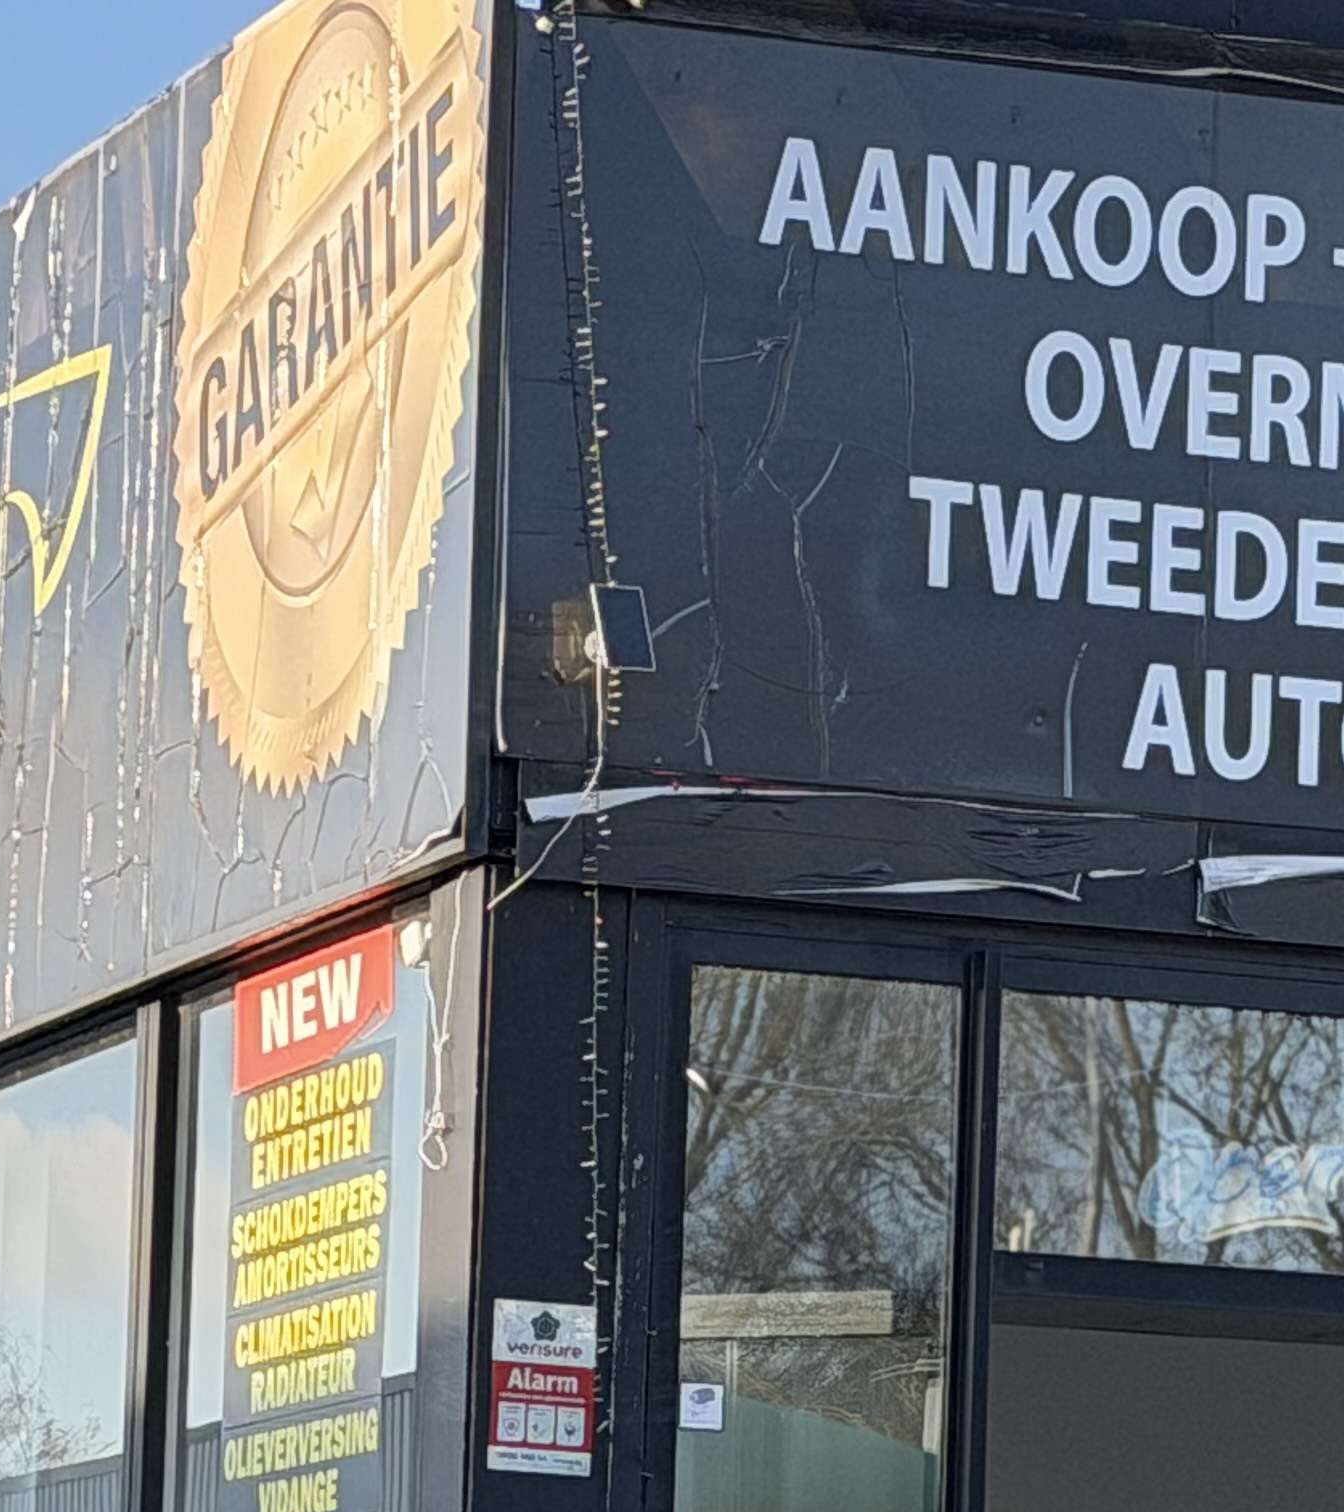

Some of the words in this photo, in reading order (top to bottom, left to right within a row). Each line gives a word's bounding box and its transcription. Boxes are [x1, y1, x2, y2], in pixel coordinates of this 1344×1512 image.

[758, 136, 1306, 303] AANKOOP
[199, 81, 456, 502] GARANTIE
[260, 953, 363, 1054] NEW
[243, 1052, 385, 1143] ONDERHOUD
[251, 1106, 372, 1190] ENTRETIEN
[231, 1169, 388, 1259] SCHOKDEMPERS
[232, 1223, 381, 1309] AMORTISSEURS
[234, 1289, 378, 1369] CLIMATISATION
[507, 1340, 584, 1360] verisure
[250, 1346, 356, 1415] RADIATEUR
[507, 1365, 579, 1395] Alarm
[223, 1407, 379, 1481] OLIEVERVERSING
